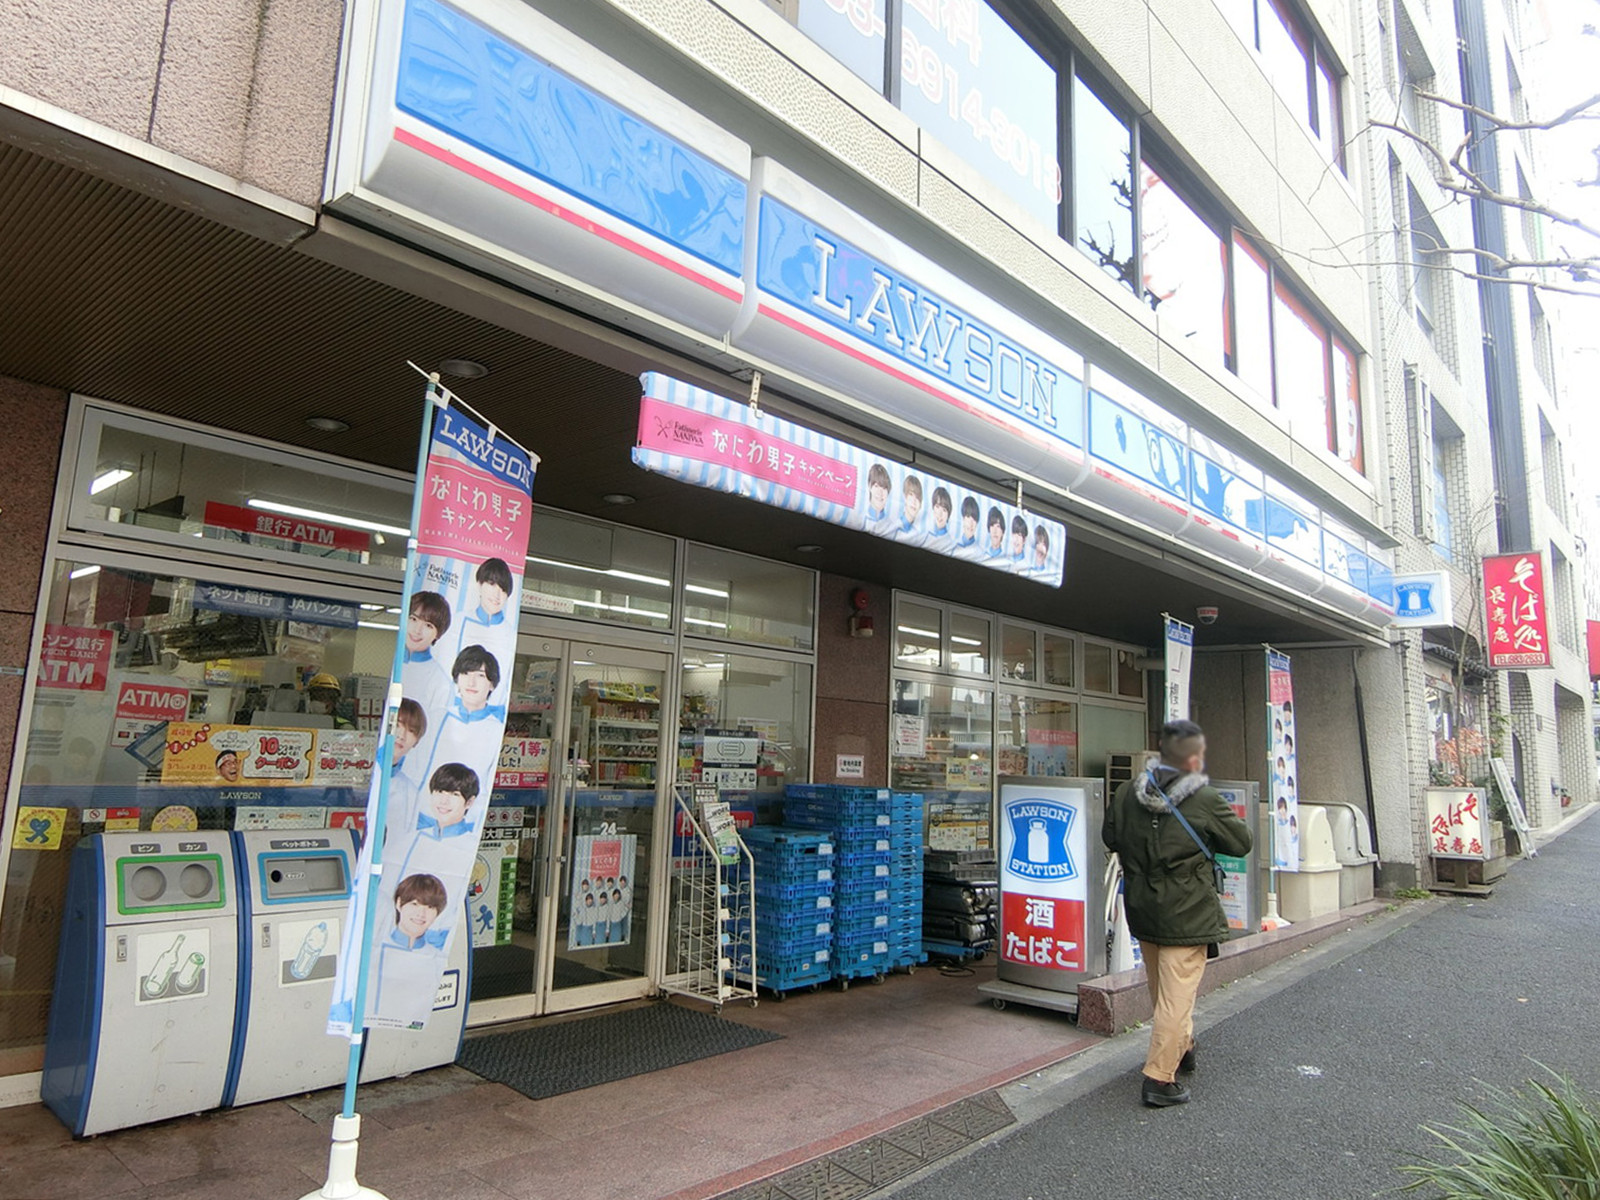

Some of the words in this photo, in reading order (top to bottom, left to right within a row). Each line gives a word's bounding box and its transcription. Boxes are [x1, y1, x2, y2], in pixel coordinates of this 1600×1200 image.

[811, 233, 1058, 429] LAWSON
[440, 415, 530, 489] LAWSON
[712, 428, 796, 475] なにわ男子
[798, 459, 853, 489] キャンペーン
[430, 475, 522, 522] なにわ男子
[256, 515, 335, 544] 銀行ATM
[441, 507, 514, 542] キャンペーン
[207, 585, 273, 606] ネット銀行
[288, 598, 341, 616] JAバンク
[1509, 557, 1542, 651] そば処
[1487, 586, 1510, 644] 長寿庵
[42, 633, 105, 651] ソン銀行
[255, 758, 300, 771] クーポン
[501, 773, 519, 784] 大安
[220, 791, 262, 800] LAWSON
[600, 822, 617, 835] 24
[1011, 805, 1069, 823] LAWSON
[1011, 858, 1069, 876] STATION
[1025, 897, 1055, 929] 酒
[1006, 932, 1079, 969] たばこ
